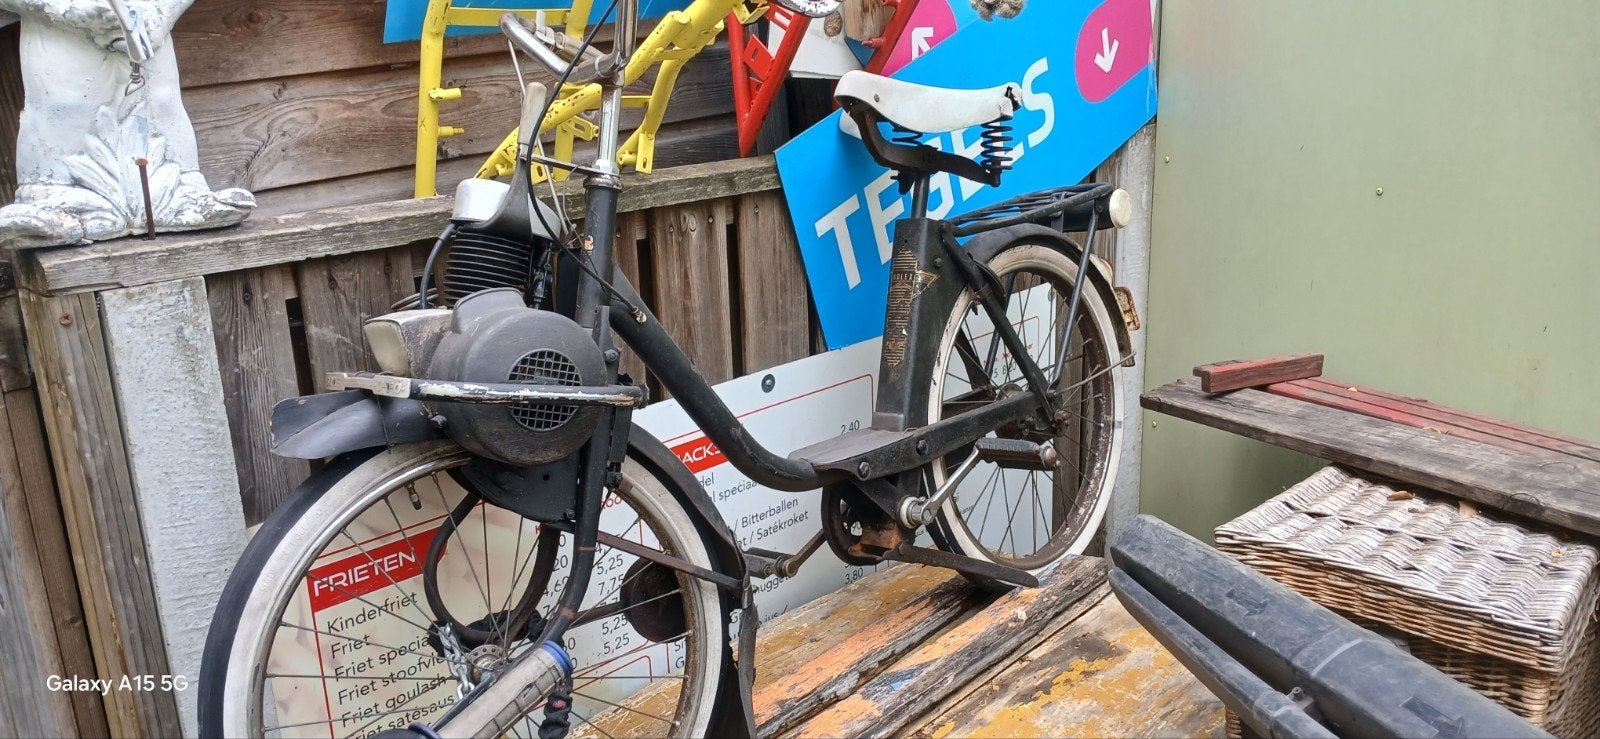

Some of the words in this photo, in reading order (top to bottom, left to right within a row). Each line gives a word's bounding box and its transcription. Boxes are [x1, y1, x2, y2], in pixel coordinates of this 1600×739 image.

[678, 442, 721, 464] ACK
[718, 480, 759, 502] speciaa
[741, 498, 799, 528] Bitterballen
[756, 510, 809, 540] Satékroket
[313, 547, 416, 597] FRIETEN
[597, 554, 624, 575] 5,25
[845, 567, 864, 585] 3,80
[327, 592, 418, 634] Kinderfriet
[601, 613, 628, 635] 5,25
[331, 634, 371, 659] Friet
[603, 633, 630, 655] 5,25
[334, 657, 374, 682] Friet
[379, 636, 430, 665] specia
[338, 680, 378, 705] Friet
[341, 702, 380, 728] Friet
[385, 673, 447, 711] goulash
[388, 694, 455, 730] satésaus
